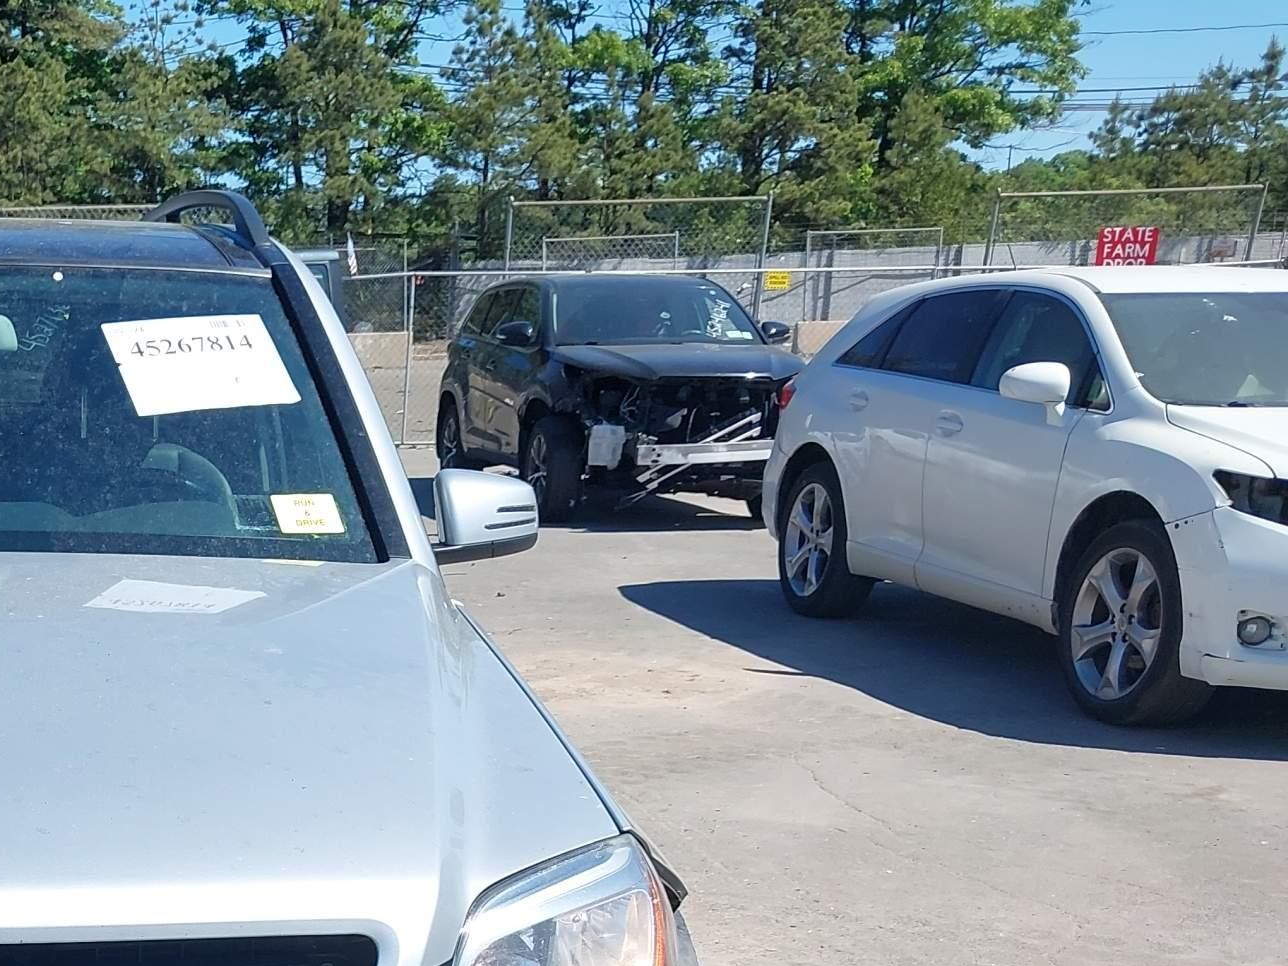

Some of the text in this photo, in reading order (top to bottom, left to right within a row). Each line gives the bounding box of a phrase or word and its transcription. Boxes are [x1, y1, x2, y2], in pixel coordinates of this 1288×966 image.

[1102, 226, 1154, 242] STATE
[1103, 242, 1151, 258] FARM
[130, 334, 254, 358] 45267814
[295, 519, 326, 528] DRIVE
